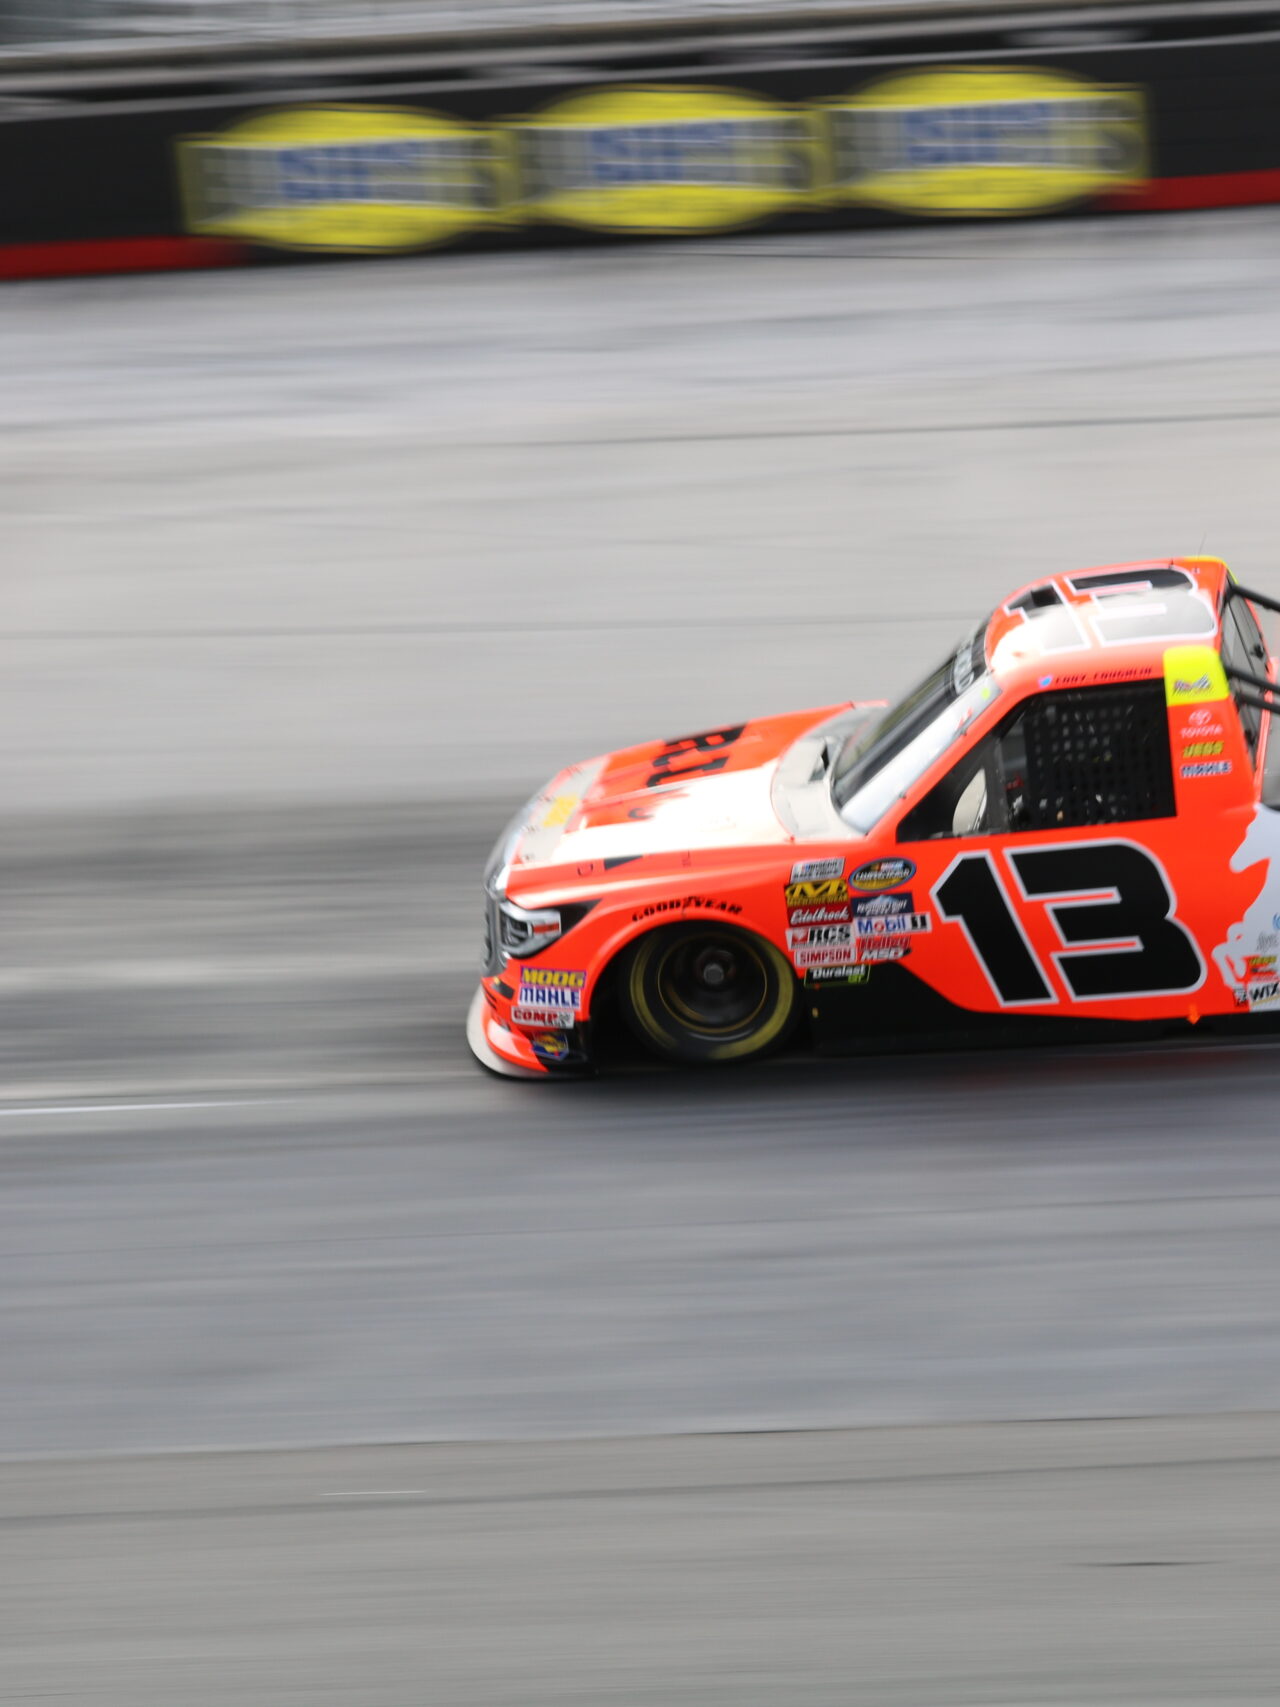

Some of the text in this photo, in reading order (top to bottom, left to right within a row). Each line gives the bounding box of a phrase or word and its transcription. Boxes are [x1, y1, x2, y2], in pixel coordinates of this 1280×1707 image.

[631, 895, 743, 922] GOODYEAR
[790, 907, 850, 924] Edelbrock
[858, 917, 906, 934] Mobil
[929, 836, 1208, 1008] 13
[800, 949, 852, 963] SIMPSON
[861, 948, 906, 961] MSD
[522, 968, 584, 986] MOOG
[811, 965, 866, 978] Duralast
[519, 988, 580, 1007] MAHLE
[1251, 982, 1280, 1001] WIX
[513, 1010, 559, 1024] COMP
